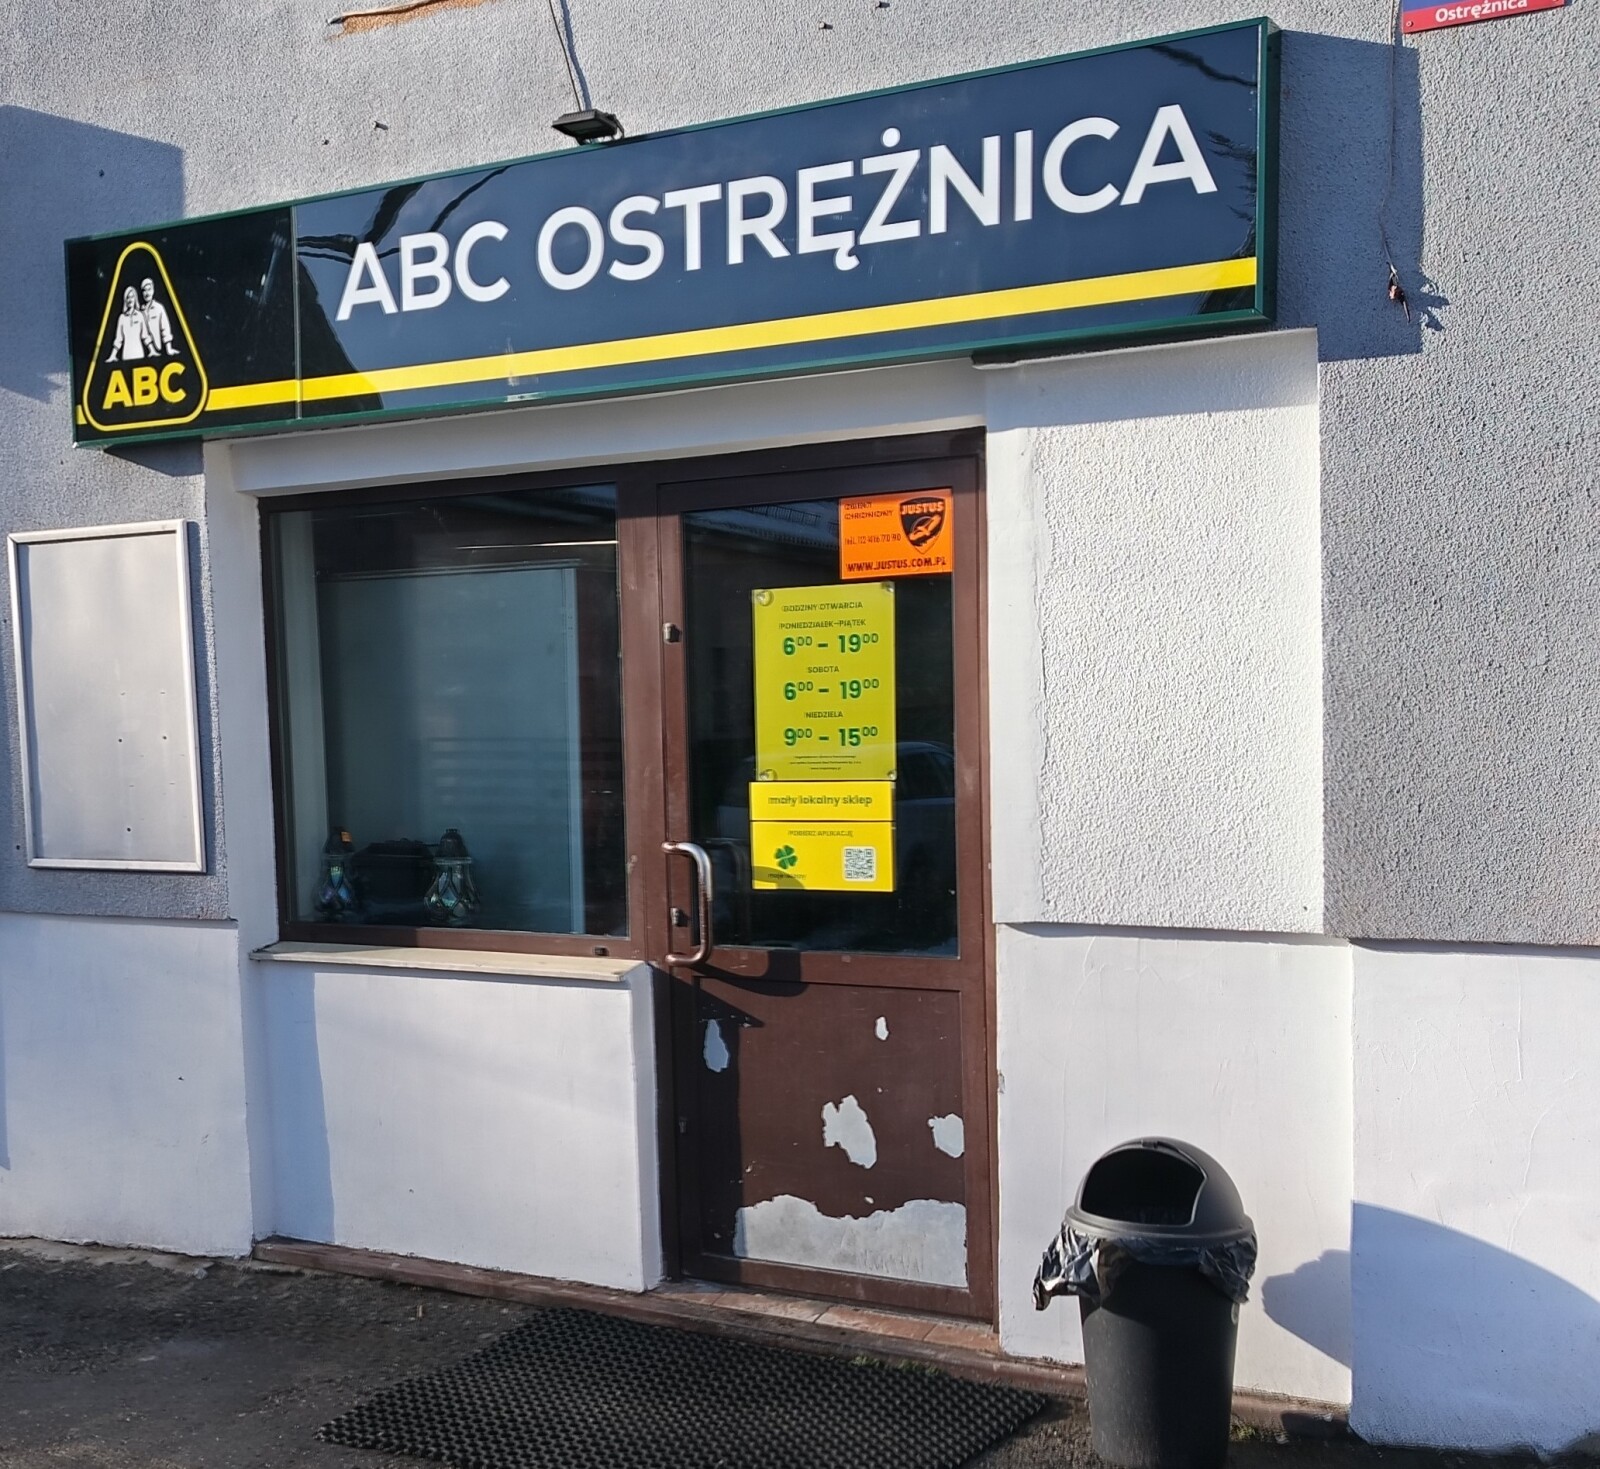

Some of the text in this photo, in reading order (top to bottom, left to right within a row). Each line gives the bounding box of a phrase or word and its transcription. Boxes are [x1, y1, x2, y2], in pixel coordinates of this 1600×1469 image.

[1435, 0, 1527, 22] Ostrężnica
[336, 104, 1218, 321] ABC OSTRĘŻNICA
[103, 362, 186, 410] ABC
[901, 501, 944, 515] JUSTUS
[846, 556, 947, 572] WWW.JUSTUS.COM.PL
[782, 602, 864, 612] GODZINY OTWARCIA
[807, 666, 840, 674] SOBOTA
[804, 711, 843, 719] NIEDZIELA
[767, 795, 873, 807] mały lokalny sklep
